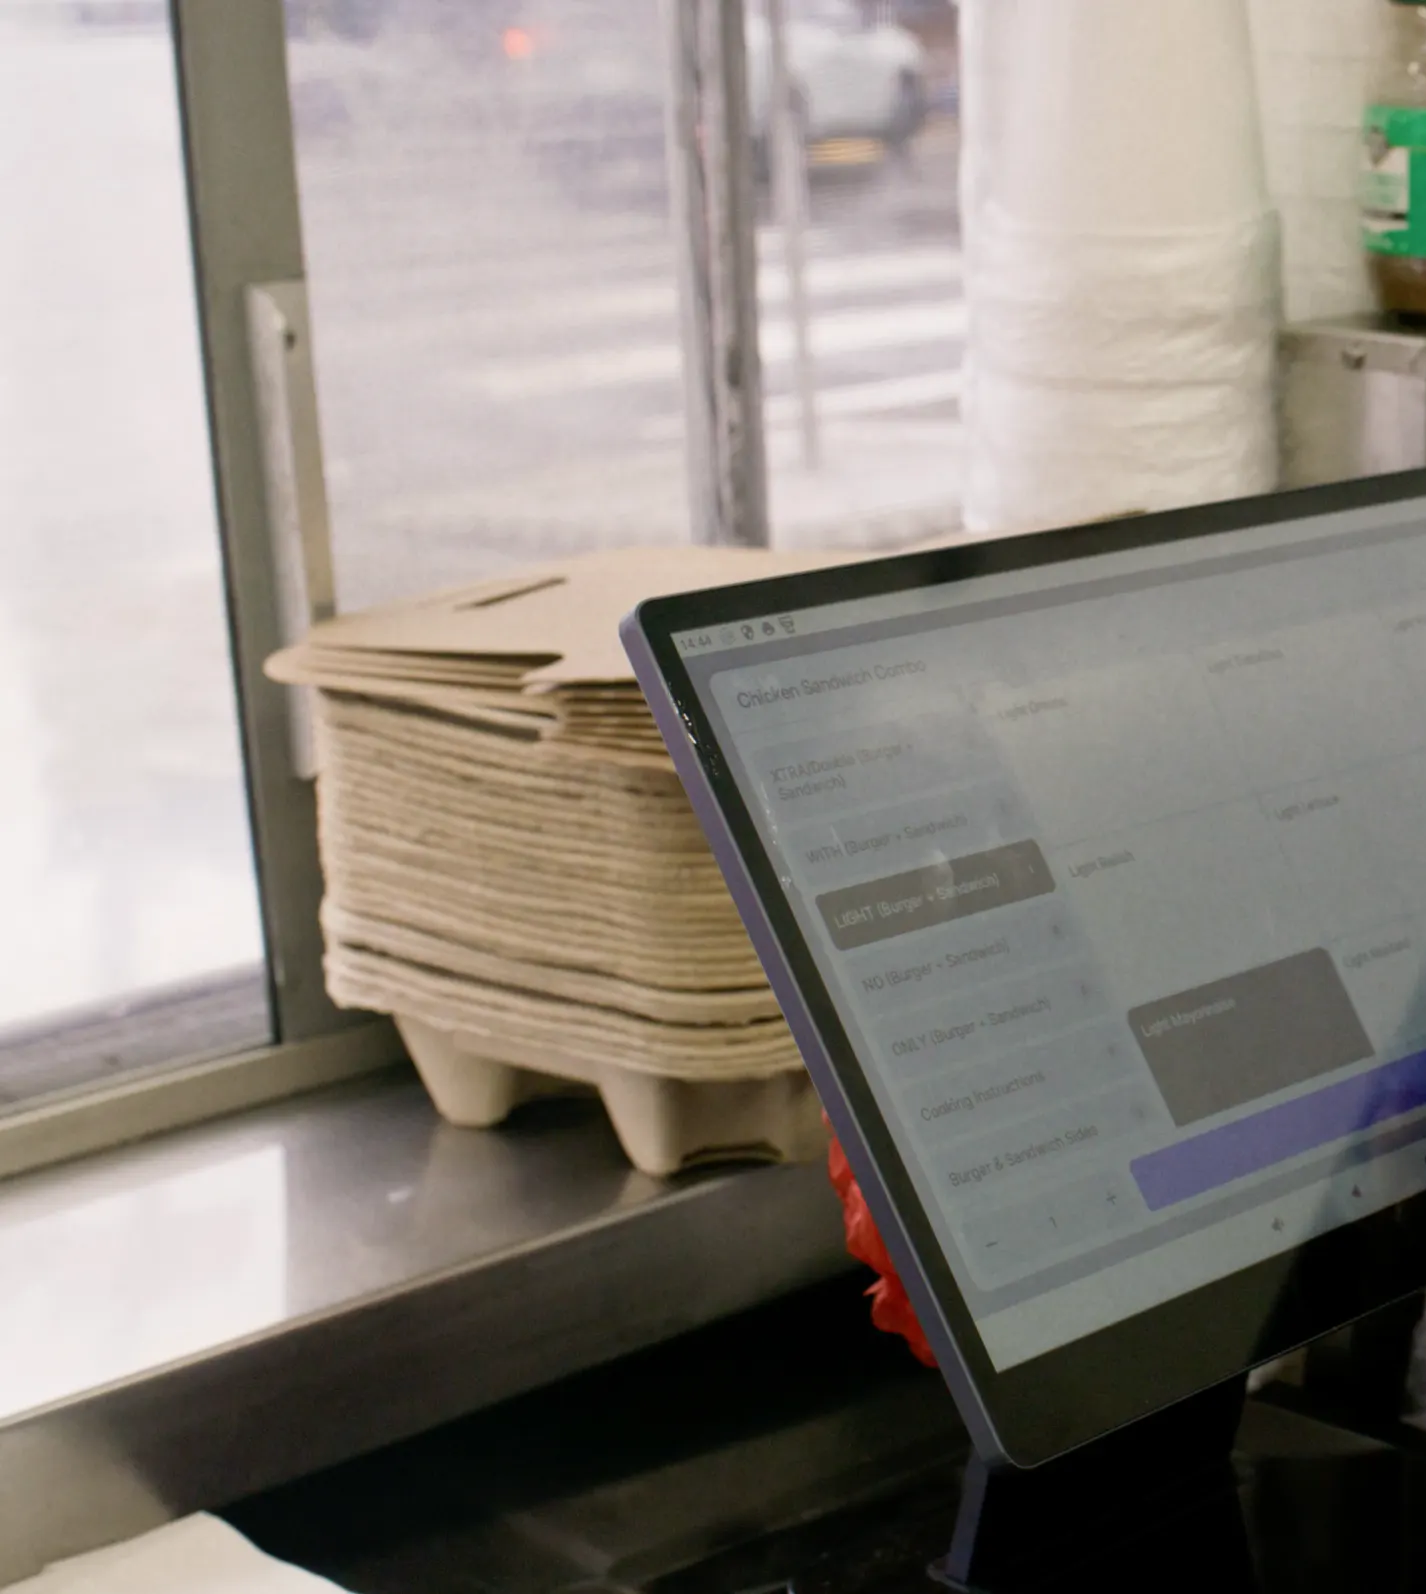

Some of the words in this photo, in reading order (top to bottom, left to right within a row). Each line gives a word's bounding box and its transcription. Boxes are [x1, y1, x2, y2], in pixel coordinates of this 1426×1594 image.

[735, 685, 799, 708] Chicken
[800, 668, 872, 695] Sandwich
[873, 660, 926, 680] Combo
[778, 776, 846, 803] Sandwich)
[844, 835, 891, 856] (Burger
[904, 814, 968, 839] Sandwich)
[834, 907, 874, 928] LIGHT
[876, 896, 924, 919] (Burger
[935, 873, 1000, 901] Sandwich)
[863, 976, 884, 992] NO
[886, 964, 934, 987] (Burger
[945, 940, 1009, 968] Sandwich)
[892, 1035, 928, 1056] ONLY
[930, 1022, 977, 1046] (Burger
[988, 997, 1051, 1026] Sandwich)
[920, 1094, 972, 1123] Cooking
[973, 1072, 1045, 1103] Instructions
[949, 1163, 995, 1188] Burger
[992, 1156, 1005, 1172] &
[1005, 1136, 1064, 1166] Sandwich
[1066, 1127, 1098, 1145] Sides
